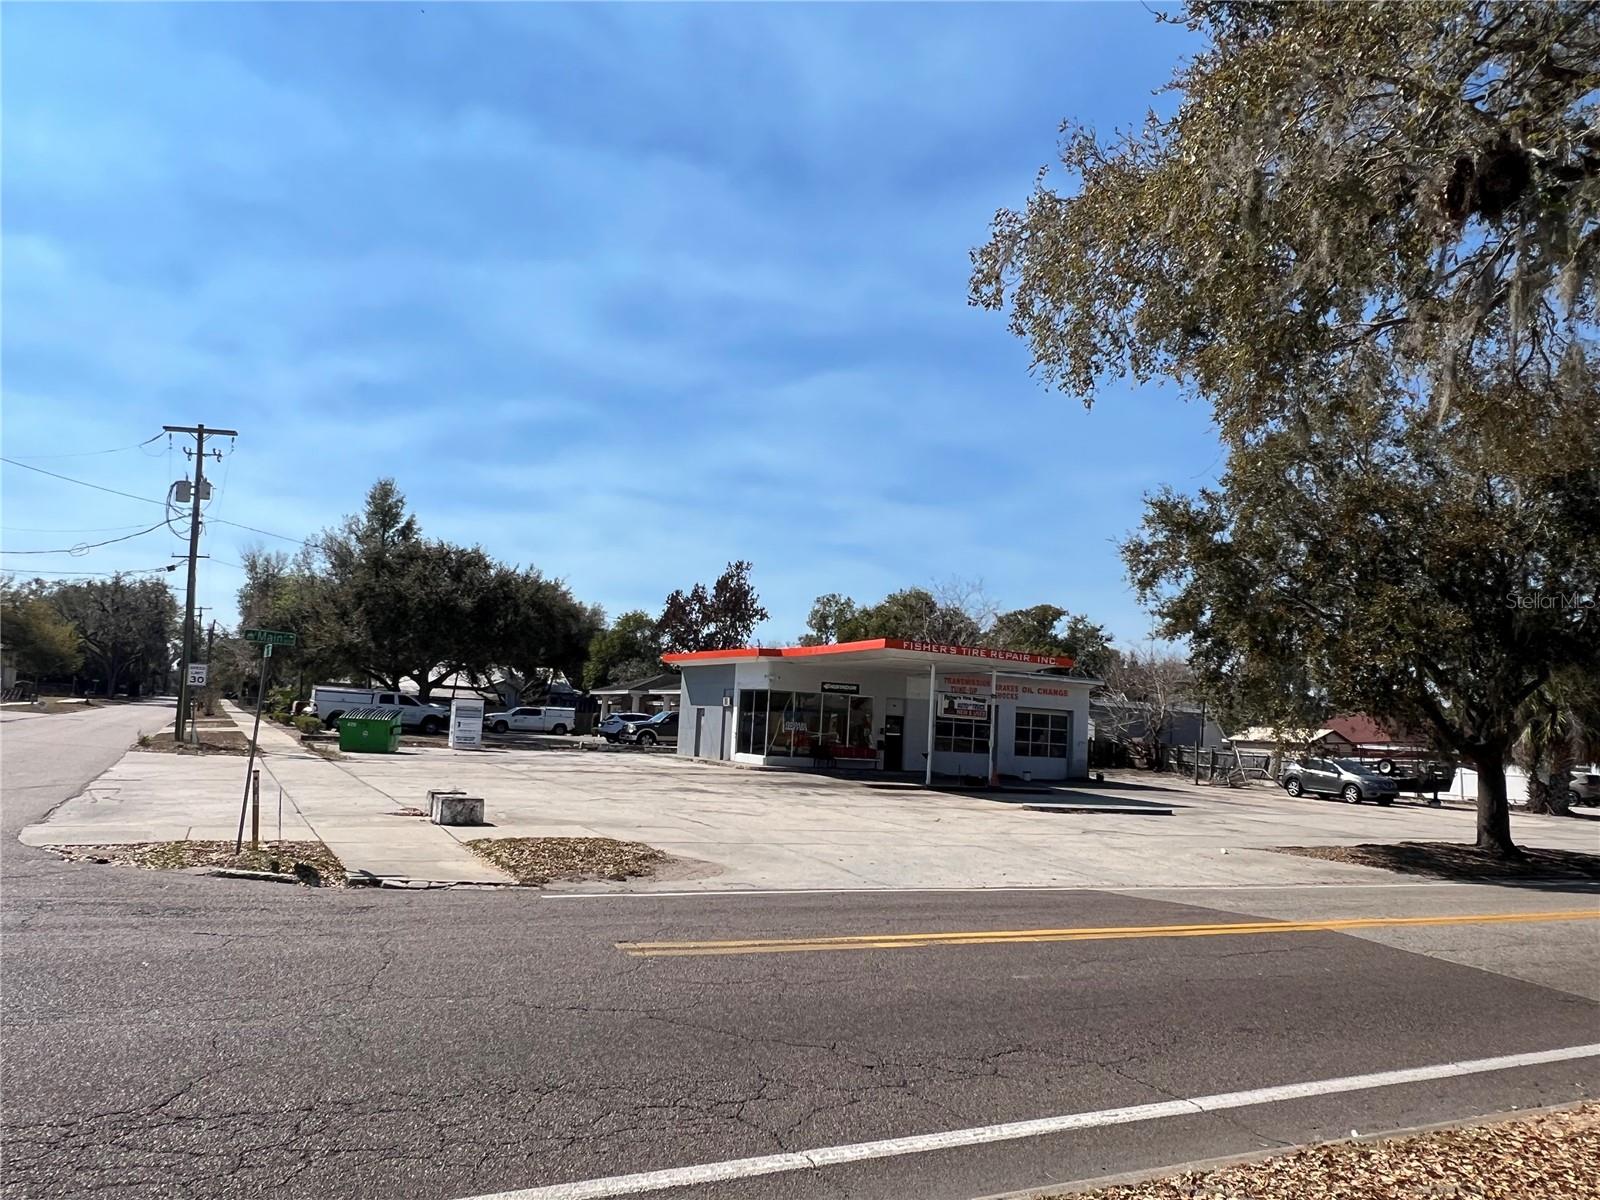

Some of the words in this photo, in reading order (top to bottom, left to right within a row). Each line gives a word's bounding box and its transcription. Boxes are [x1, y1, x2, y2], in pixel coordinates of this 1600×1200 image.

[257, 631, 283, 642] Main
[961, 647, 987, 658] TIRE
[189, 675, 205, 683] 30
[1022, 686, 1034, 694] OIL
[1037, 687, 1069, 697] CHANGE
